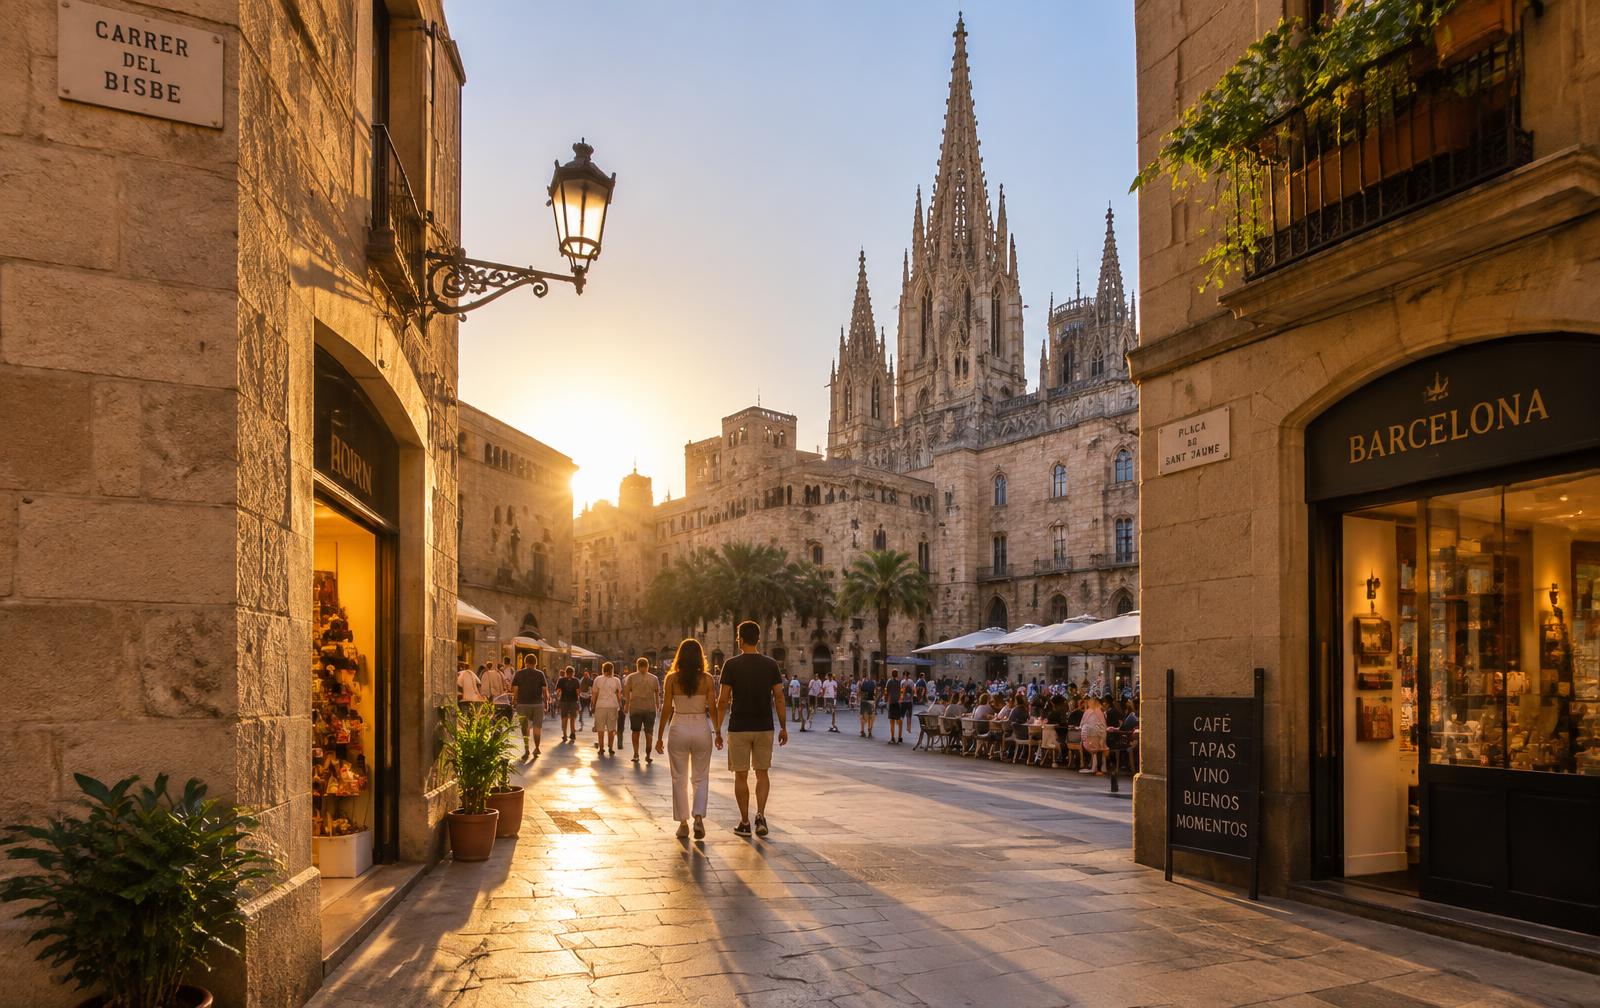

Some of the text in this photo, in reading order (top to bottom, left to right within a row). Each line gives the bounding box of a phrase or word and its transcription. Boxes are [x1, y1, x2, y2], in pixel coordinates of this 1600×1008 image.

[96, 20, 189, 57] CARRER
[123, 52, 161, 75] DEL
[104, 71, 181, 104] BISBE
[1349, 388, 1549, 464] BARCELONA
[1165, 452, 1187, 466] SANT
[1189, 742, 1236, 760] TAPAS
[1193, 766, 1230, 784] VINO
[1184, 790, 1240, 811] BUENOS
[1176, 813, 1248, 838] MOMENTOS
